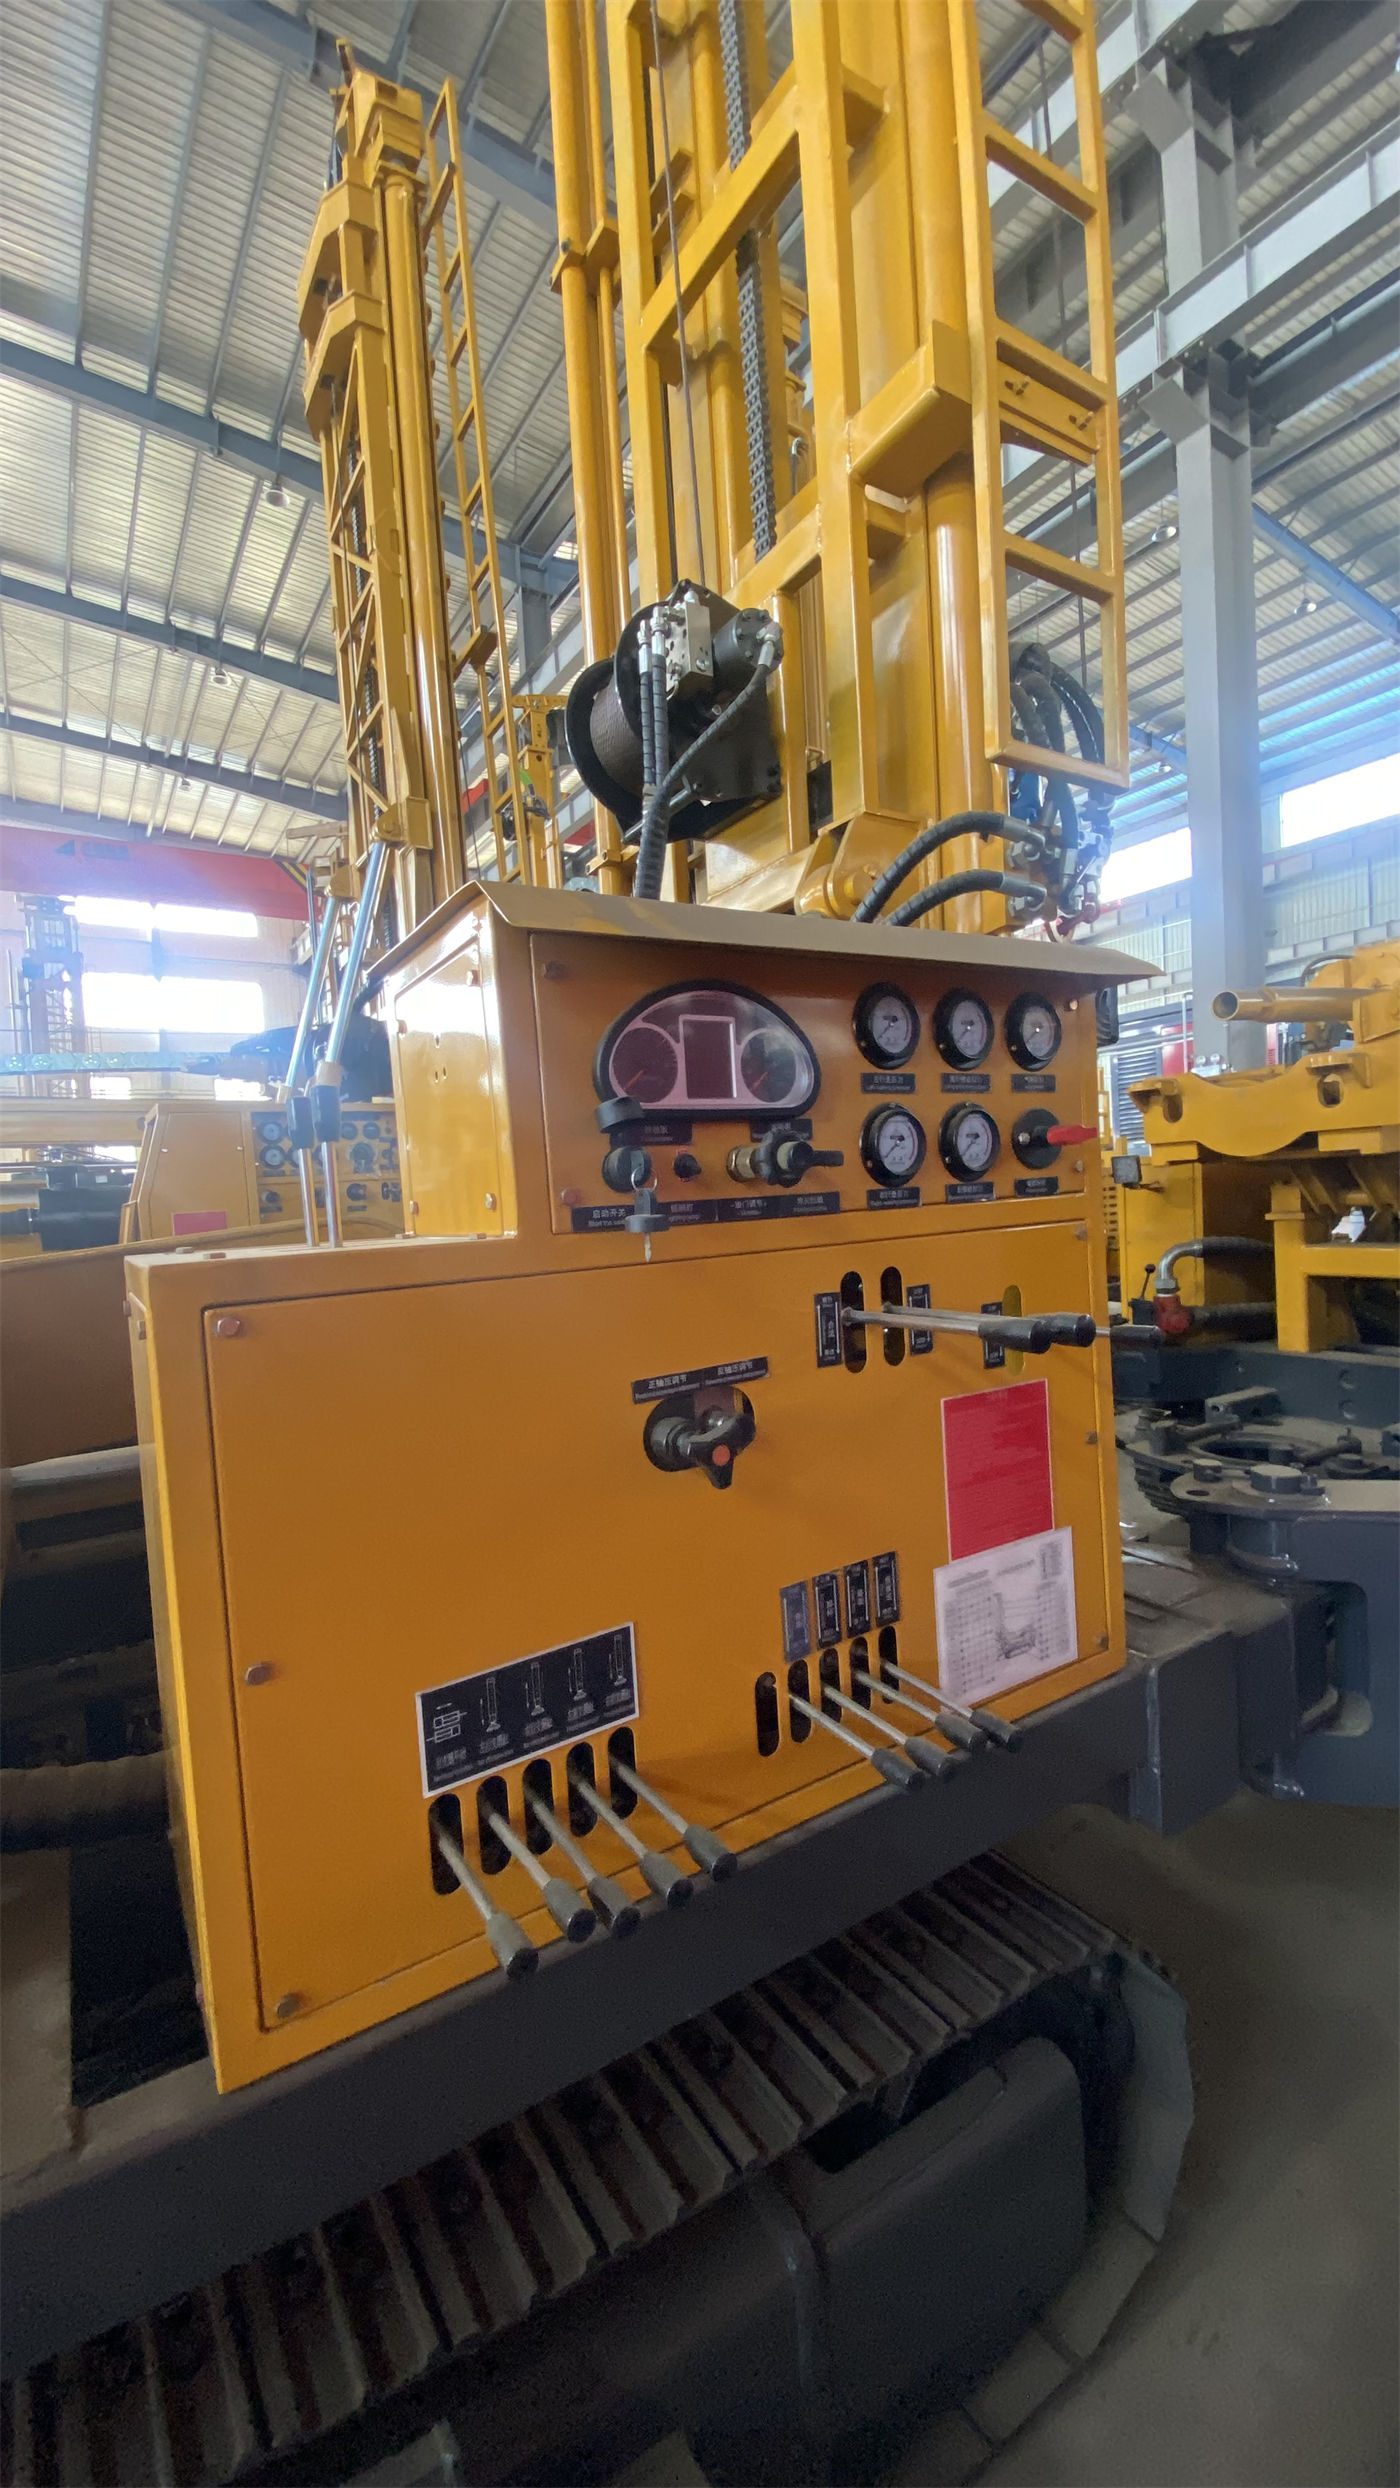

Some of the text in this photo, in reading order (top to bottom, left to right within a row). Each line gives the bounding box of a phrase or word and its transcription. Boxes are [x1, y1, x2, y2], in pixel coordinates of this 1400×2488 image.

[648, 1374, 688, 1389] 正轴压调节
